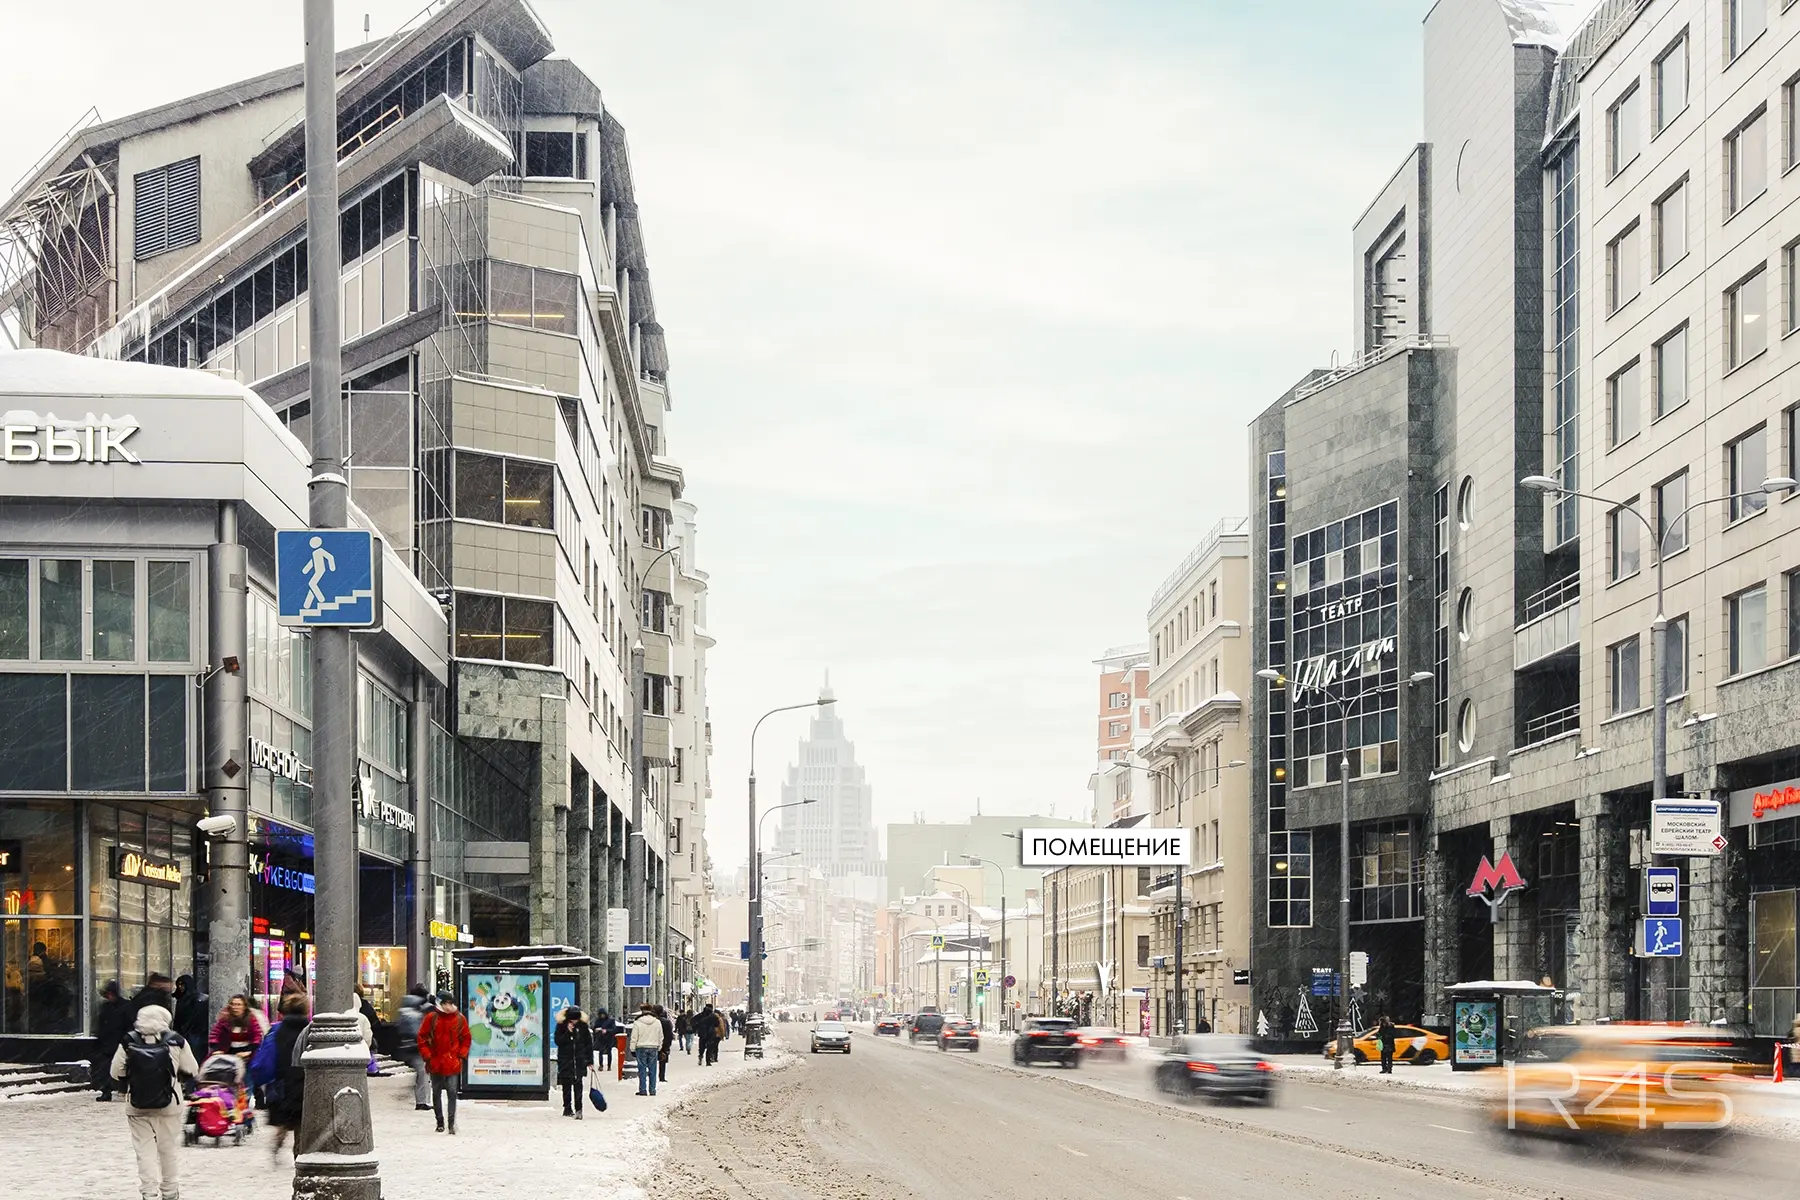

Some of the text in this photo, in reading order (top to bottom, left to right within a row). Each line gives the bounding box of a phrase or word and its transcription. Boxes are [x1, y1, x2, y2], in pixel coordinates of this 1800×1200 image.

[4, 425, 141, 463] БЫК
[1320, 597, 1362, 621] ТЕАТР
[1293, 638, 1394, 703] Шалом
[249, 736, 299, 783] МЯСНОЙ
[380, 800, 415, 833] РЕСТОРАН
